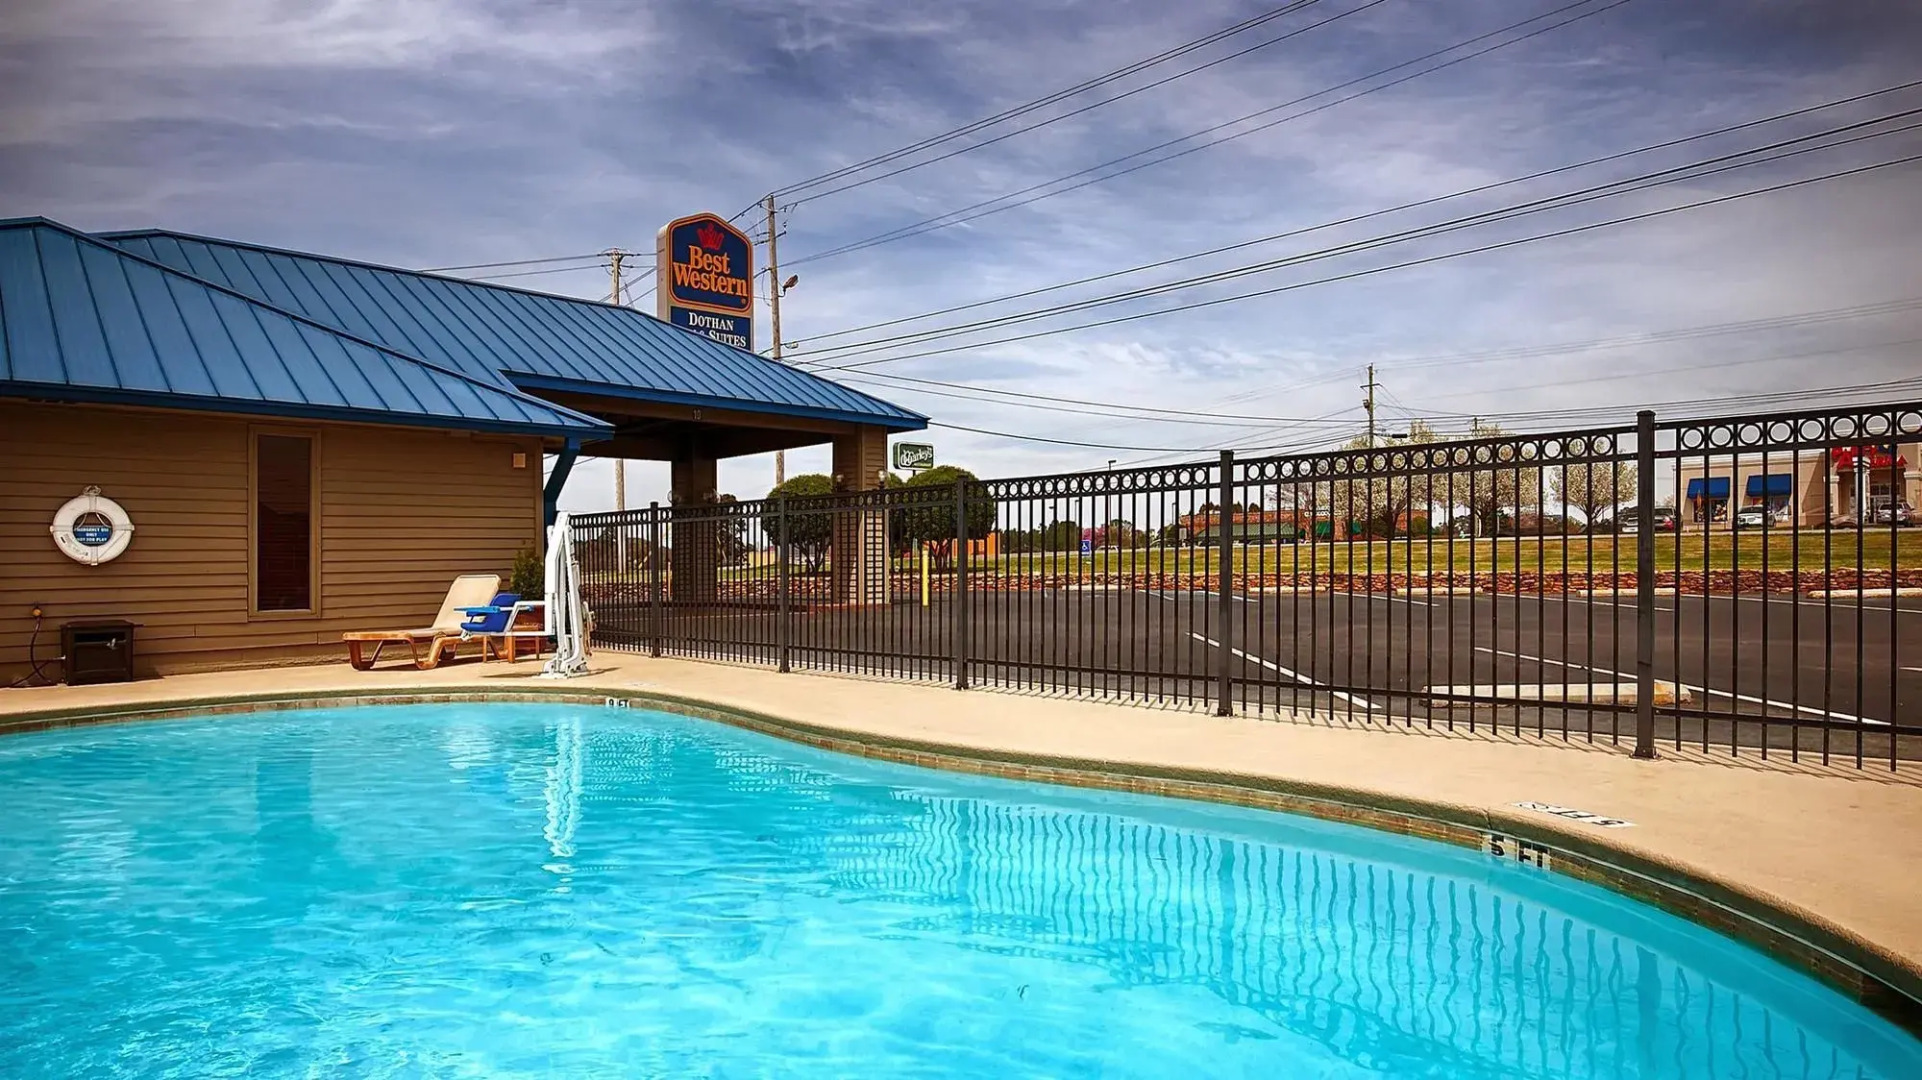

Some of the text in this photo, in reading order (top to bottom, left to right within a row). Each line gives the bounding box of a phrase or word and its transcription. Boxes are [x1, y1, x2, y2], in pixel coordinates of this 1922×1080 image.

[689, 245, 730, 274] Best
[673, 262, 748, 296] Western
[689, 312, 734, 331] DOTHAN
[1489, 833, 1549, 868] 5 FT
